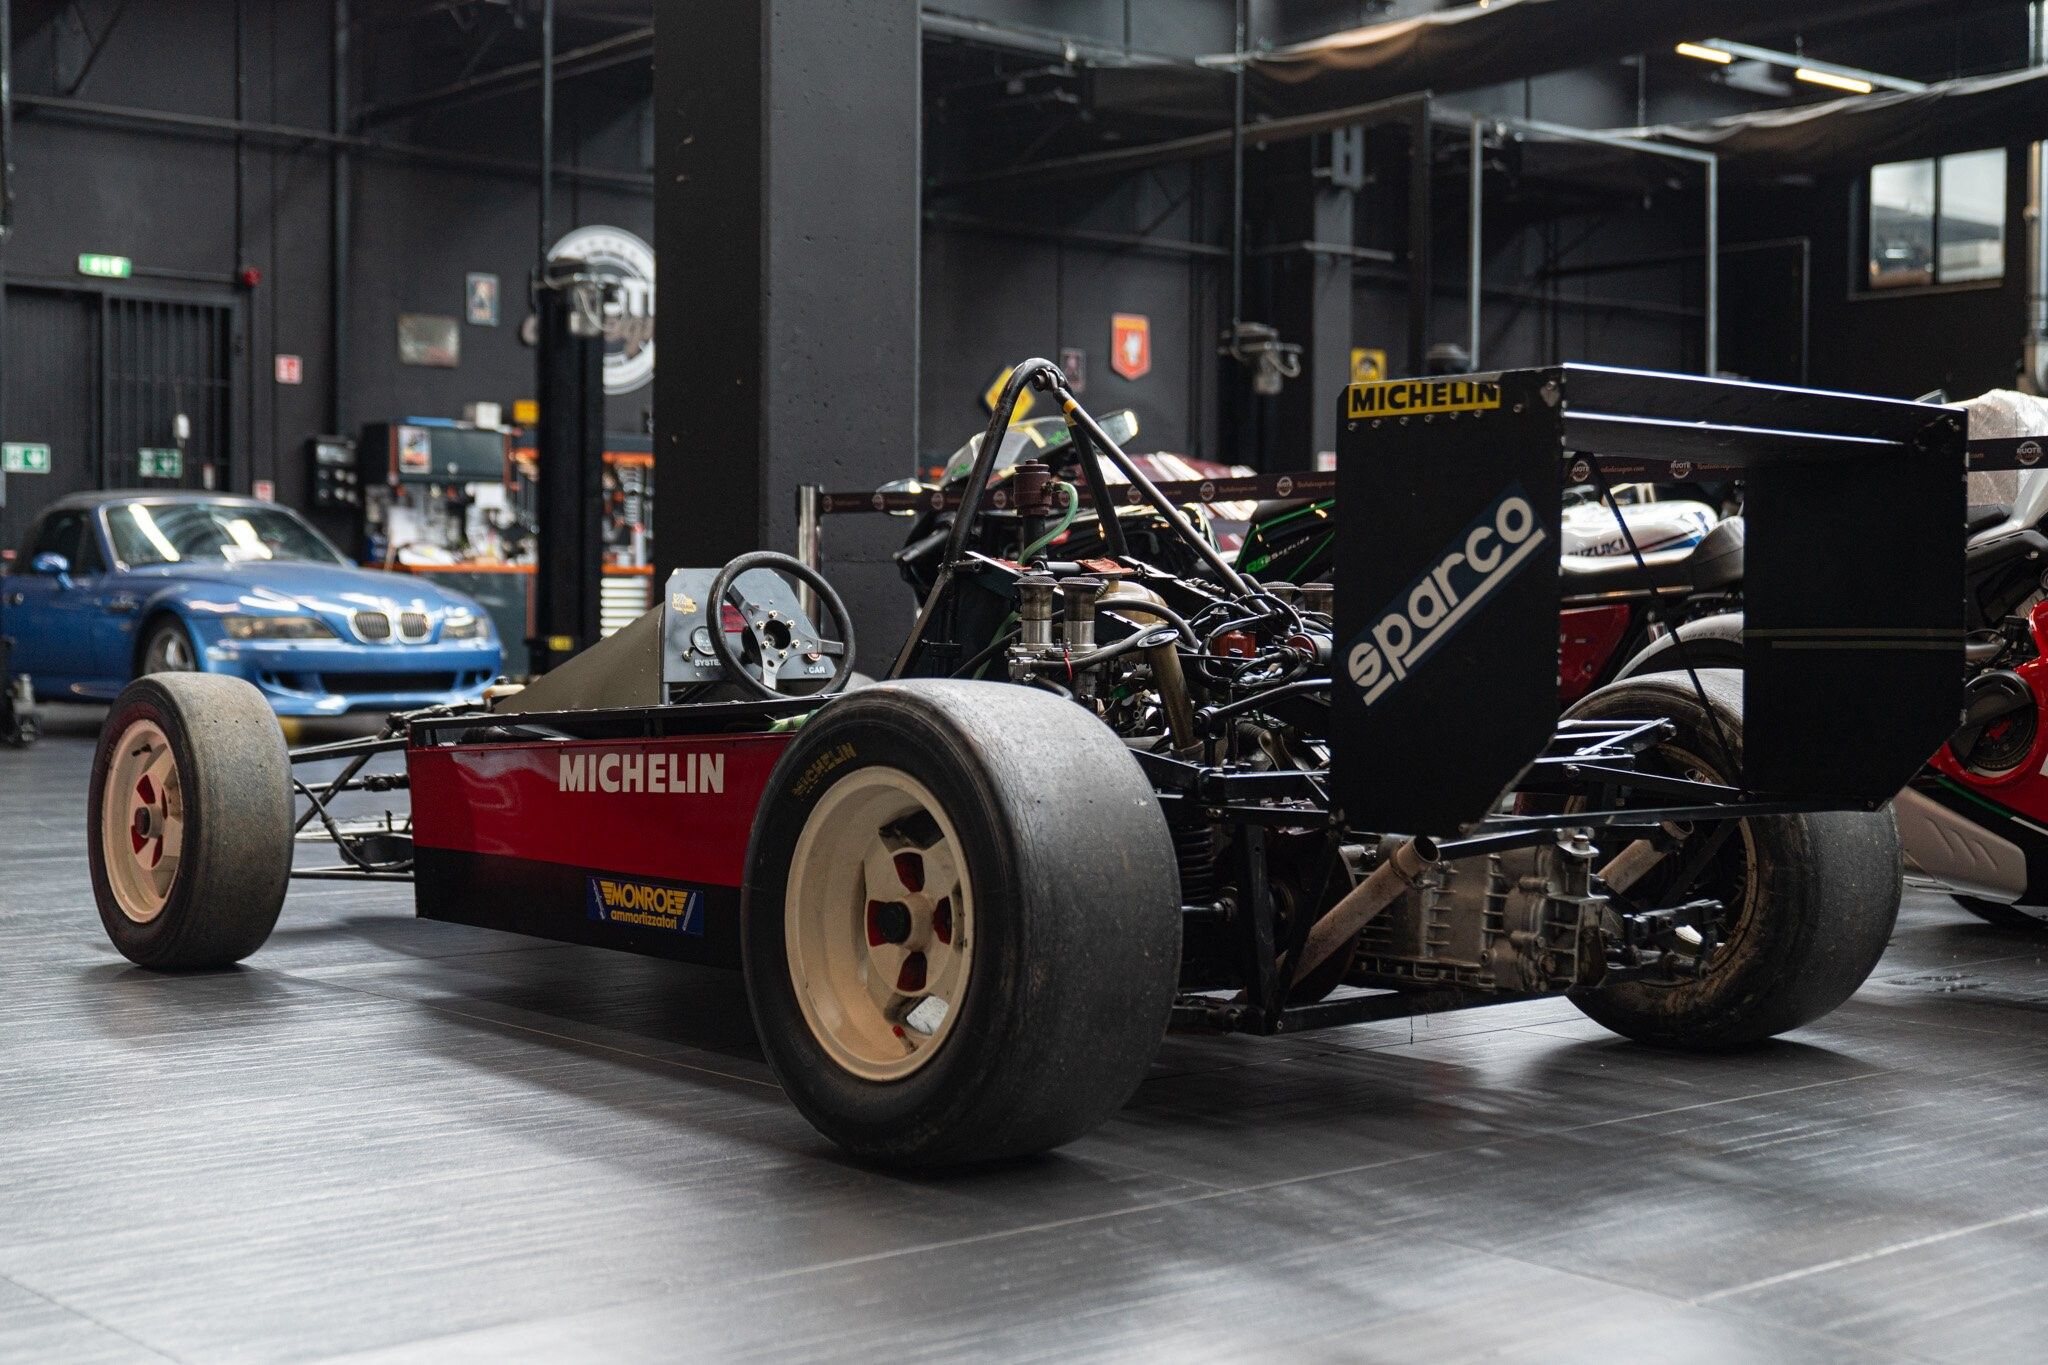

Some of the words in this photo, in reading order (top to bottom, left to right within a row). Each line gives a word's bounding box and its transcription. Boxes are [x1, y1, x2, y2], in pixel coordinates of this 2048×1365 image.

[1352, 381, 1497, 412] MICHELIN
[1348, 497, 1533, 687] sparco
[695, 658, 721, 667] SYSTE
[809, 666, 826, 674] CAR
[559, 753, 725, 793] MICHELIN
[610, 882, 678, 915] MONROE
[611, 909, 677, 930] ammortizzatori
